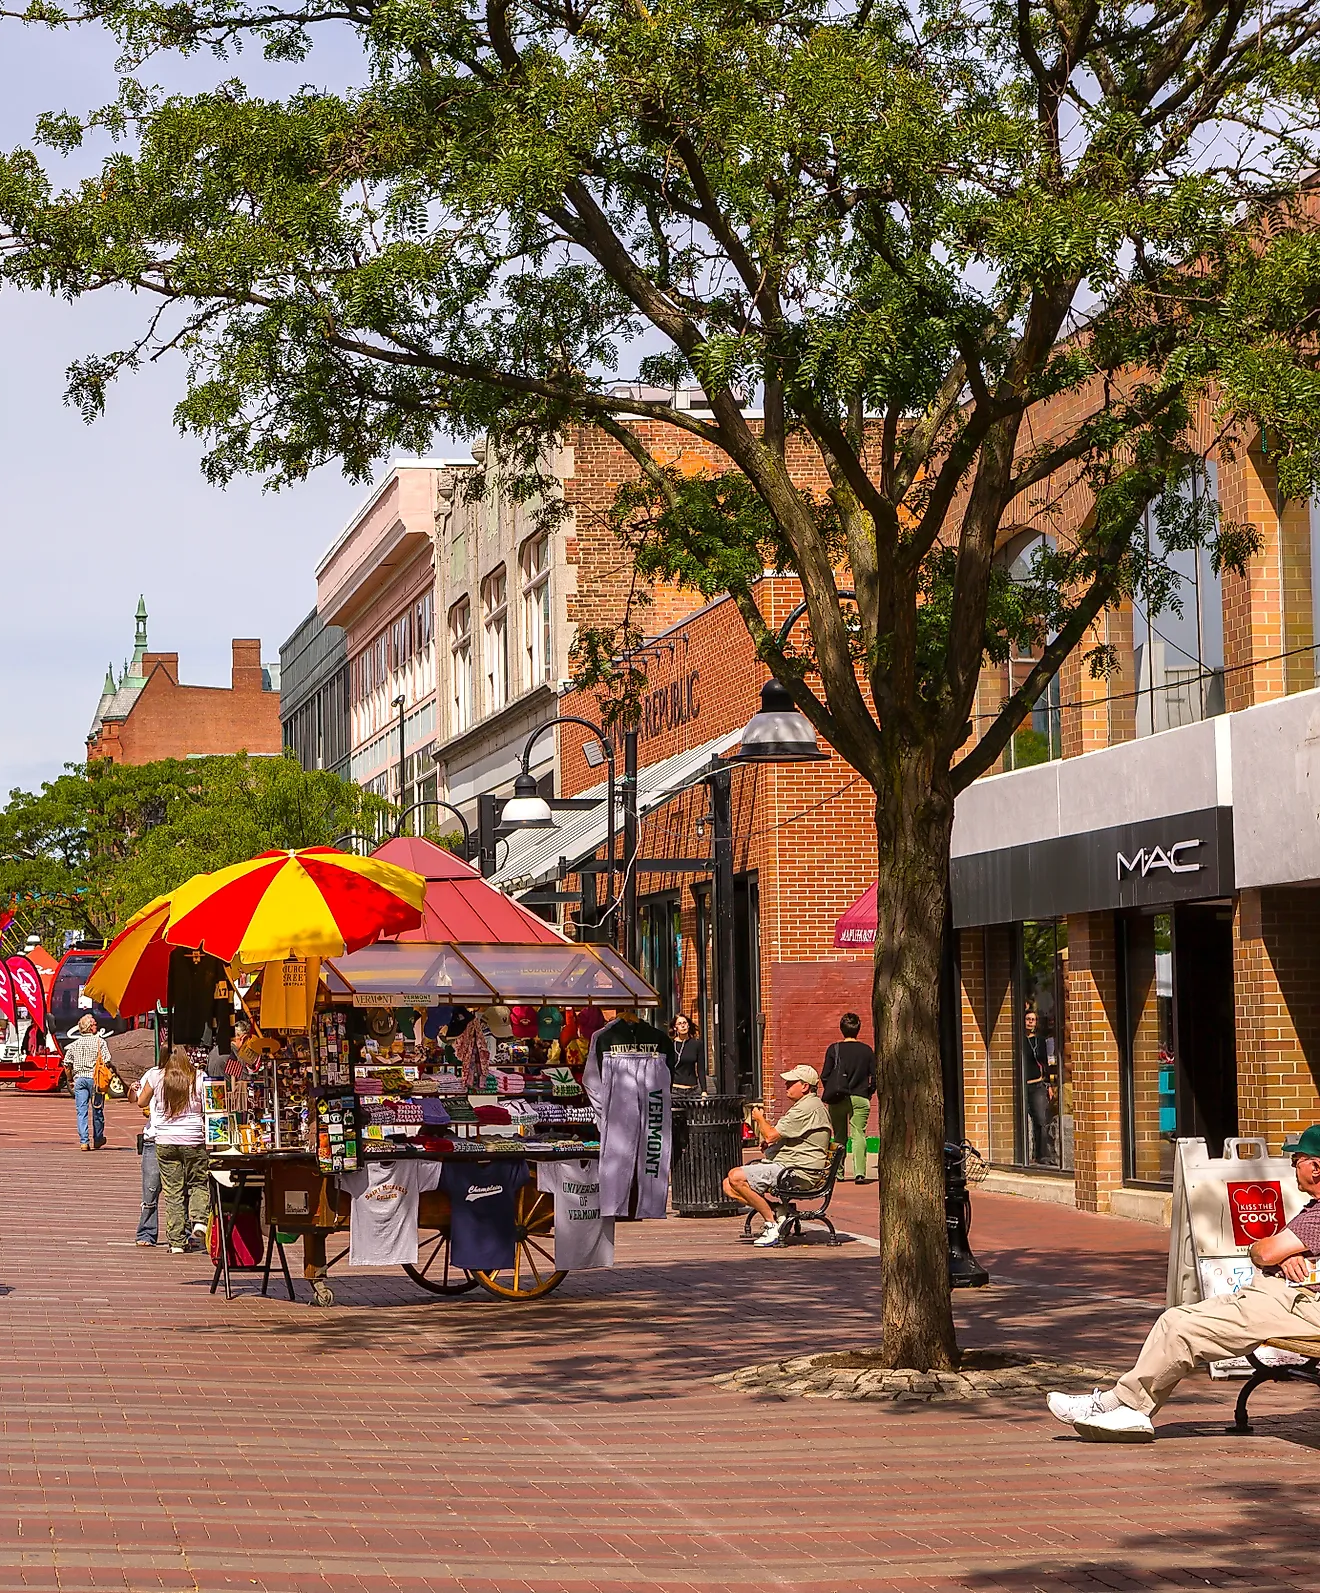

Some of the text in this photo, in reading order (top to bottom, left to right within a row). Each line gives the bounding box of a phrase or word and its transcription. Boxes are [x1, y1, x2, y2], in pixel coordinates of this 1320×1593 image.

[644, 670, 700, 740] REPUBLIC
[356, 994, 394, 1005] VERMONT
[644, 1089, 663, 1178] VERMONT
[579, 1197, 588, 1207] OF
[1239, 1213, 1278, 1223] COOK
